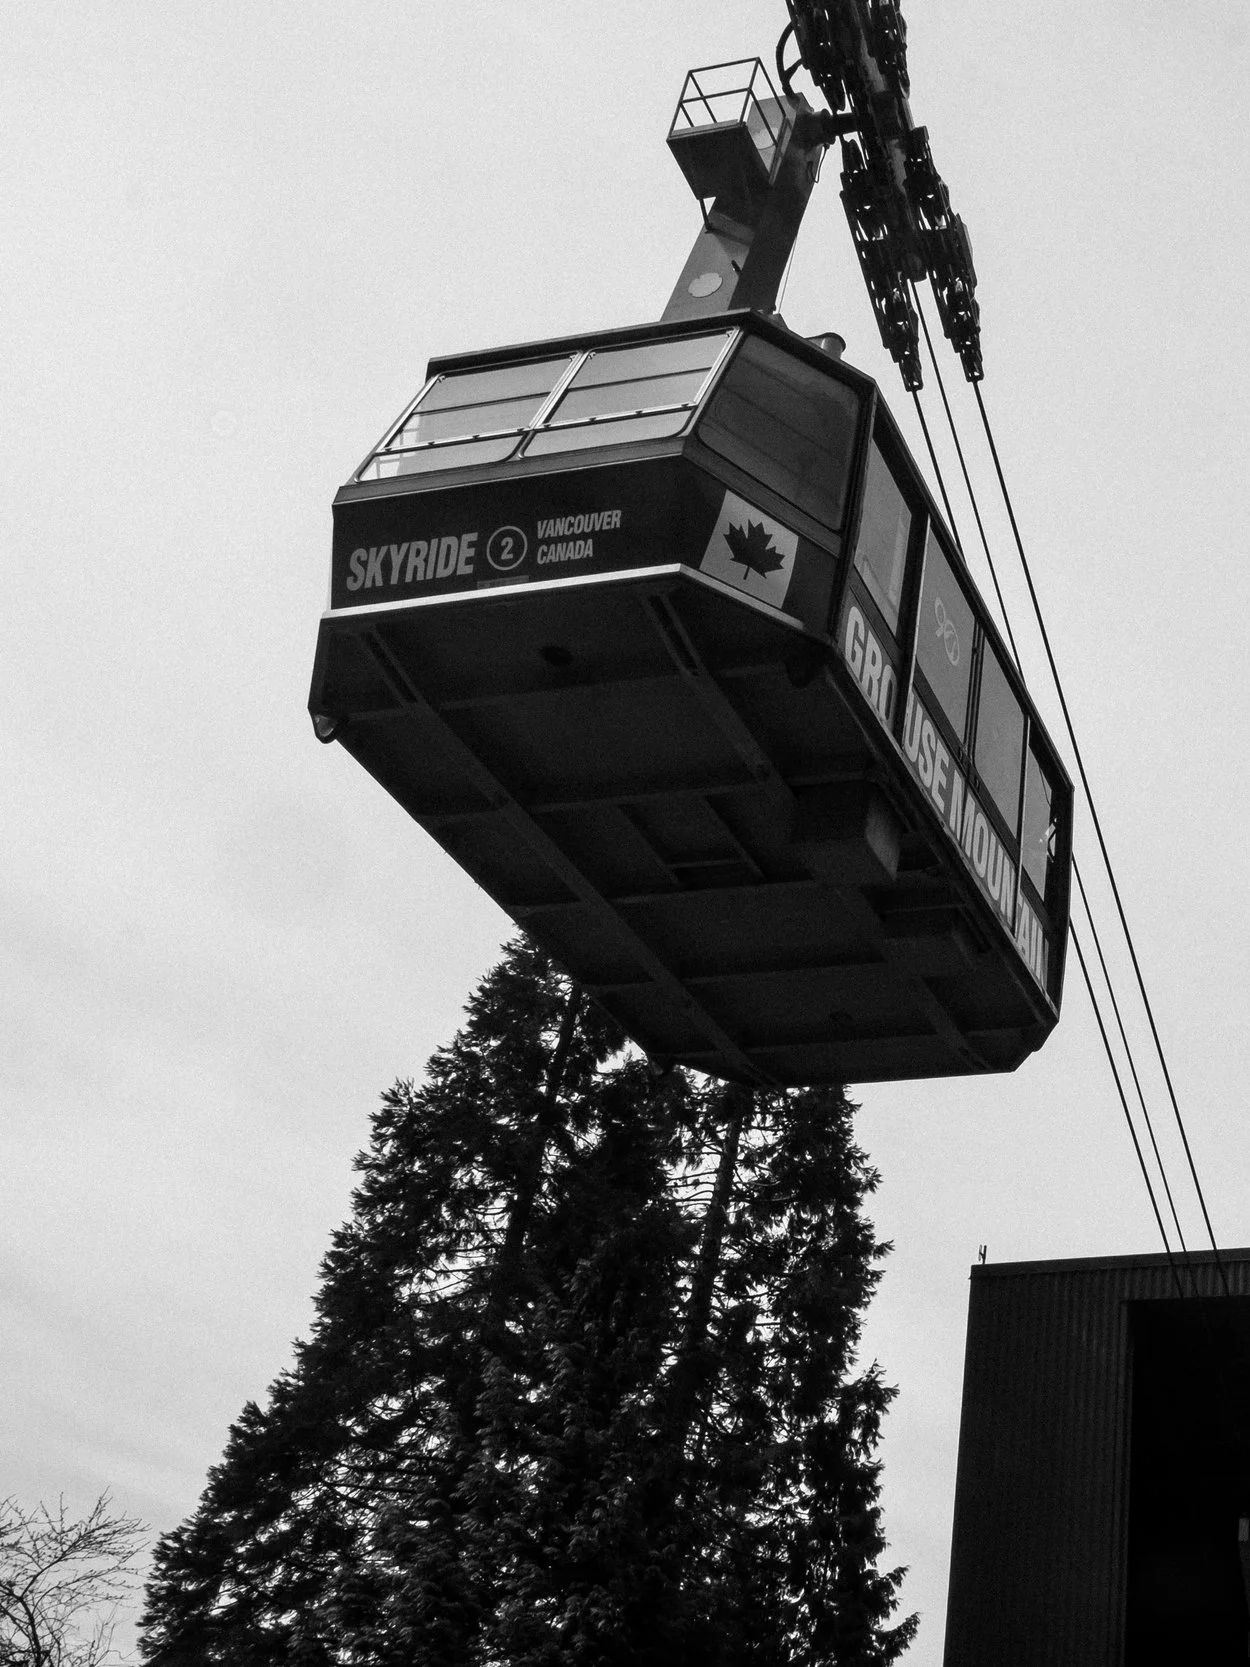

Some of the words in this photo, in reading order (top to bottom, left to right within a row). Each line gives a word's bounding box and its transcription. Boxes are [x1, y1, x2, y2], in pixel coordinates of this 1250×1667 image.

[537, 509, 622, 540] VANCOUVER
[346, 532, 478, 591] SKYRIDE
[500, 536, 514, 561] 2
[536, 538, 594, 565] CANADA
[845, 606, 950, 814] GROUSE
